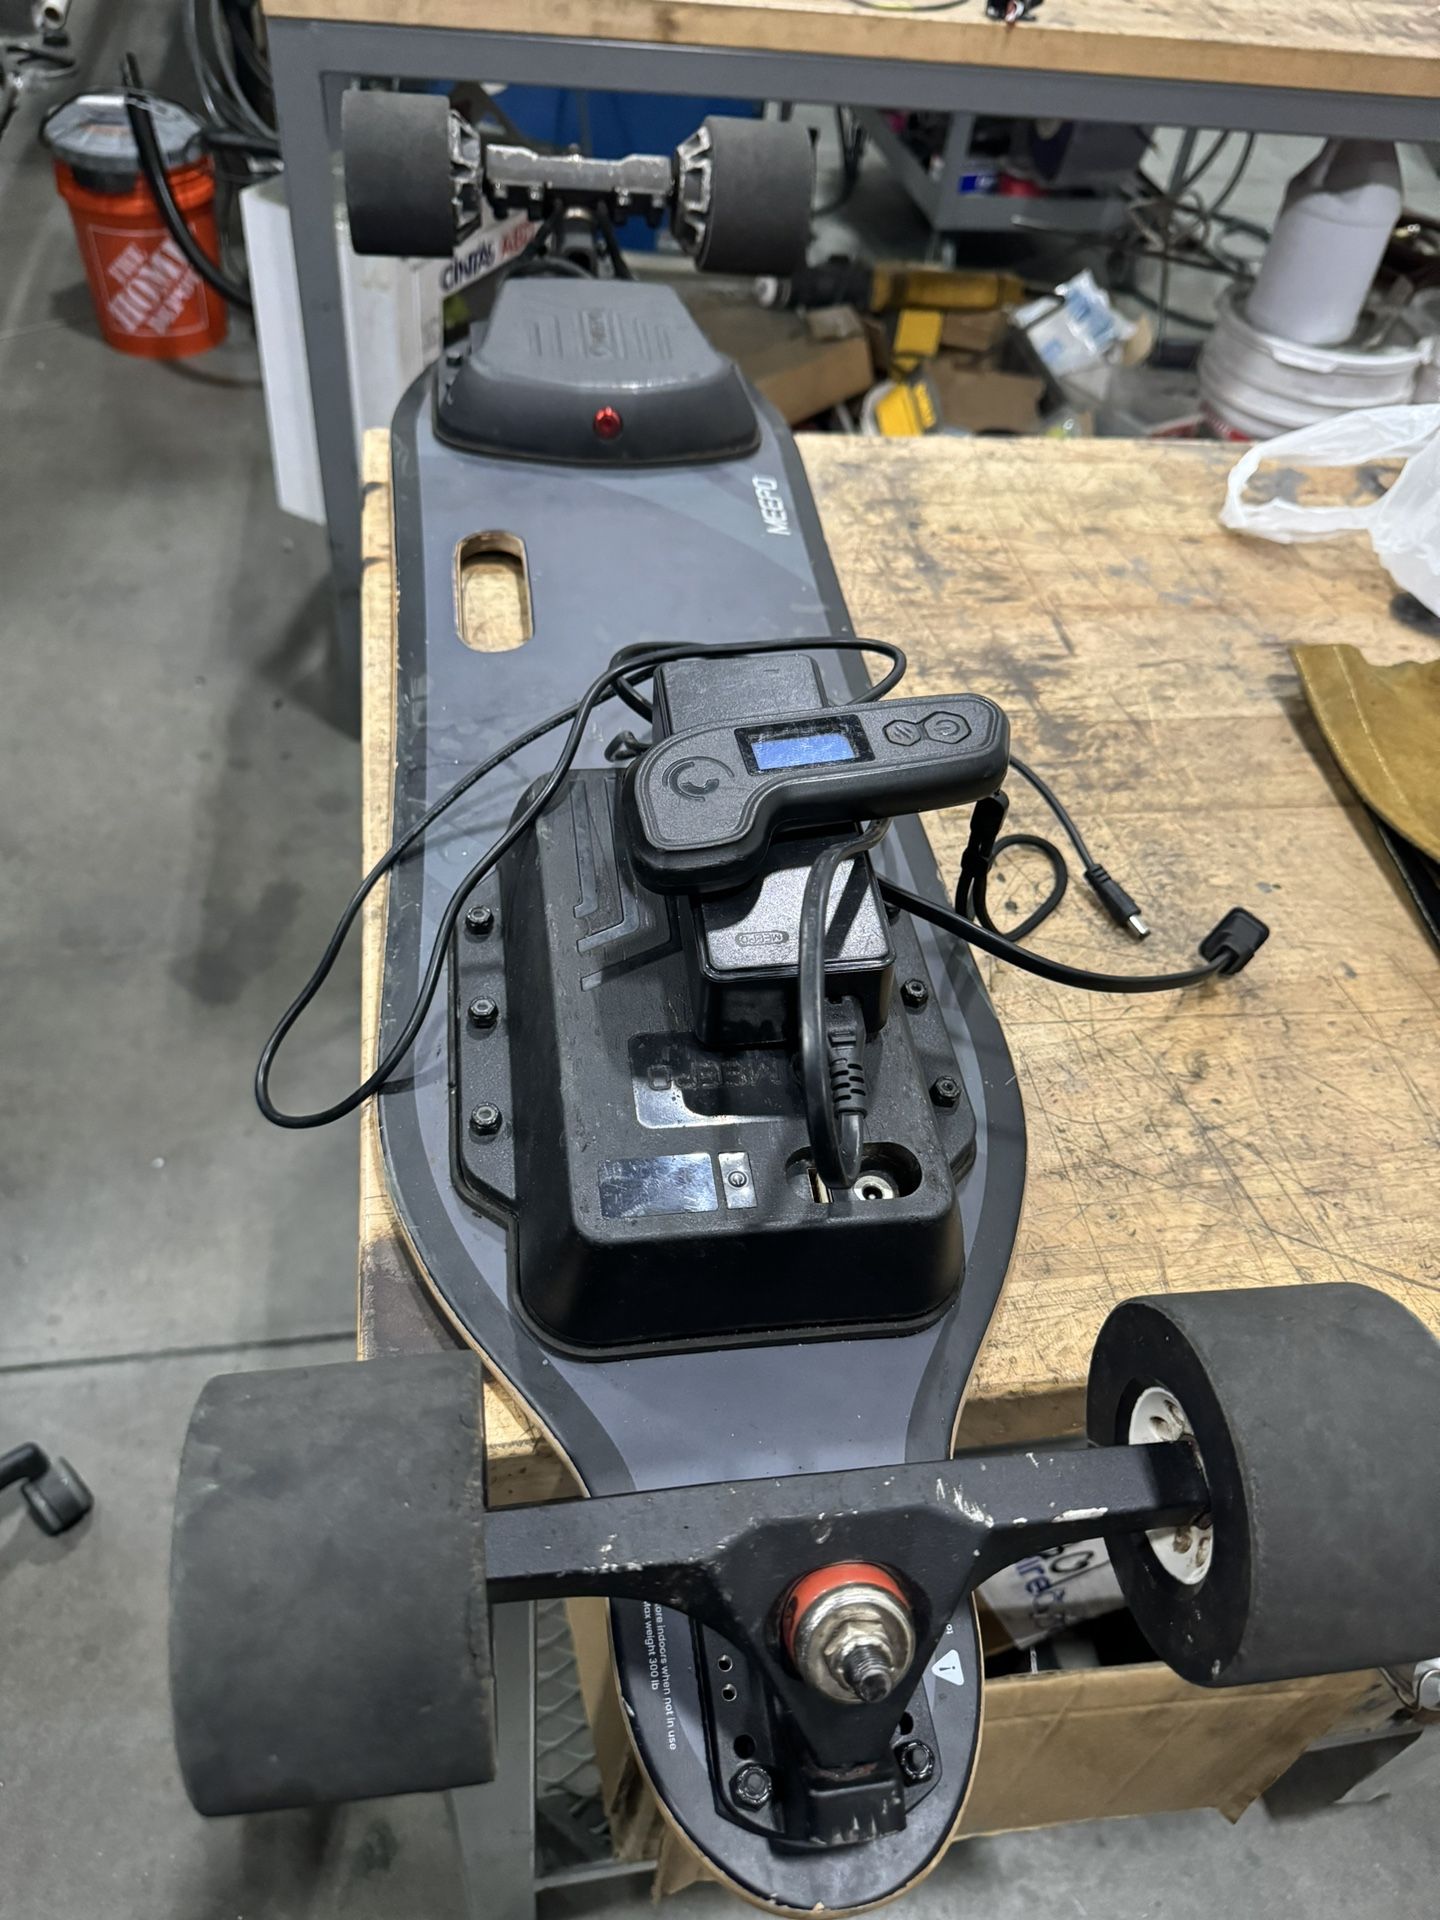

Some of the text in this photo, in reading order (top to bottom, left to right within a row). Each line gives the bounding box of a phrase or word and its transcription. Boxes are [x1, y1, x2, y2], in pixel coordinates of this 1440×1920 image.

[752, 474, 791, 536] MEEPO
[740, 933, 781, 944] MEEPO
[645, 1620, 656, 1655] weight
[649, 1657, 660, 1677] 300
[655, 1604, 677, 1750] ore indoors when not in use
[651, 1679, 660, 1690] lb
